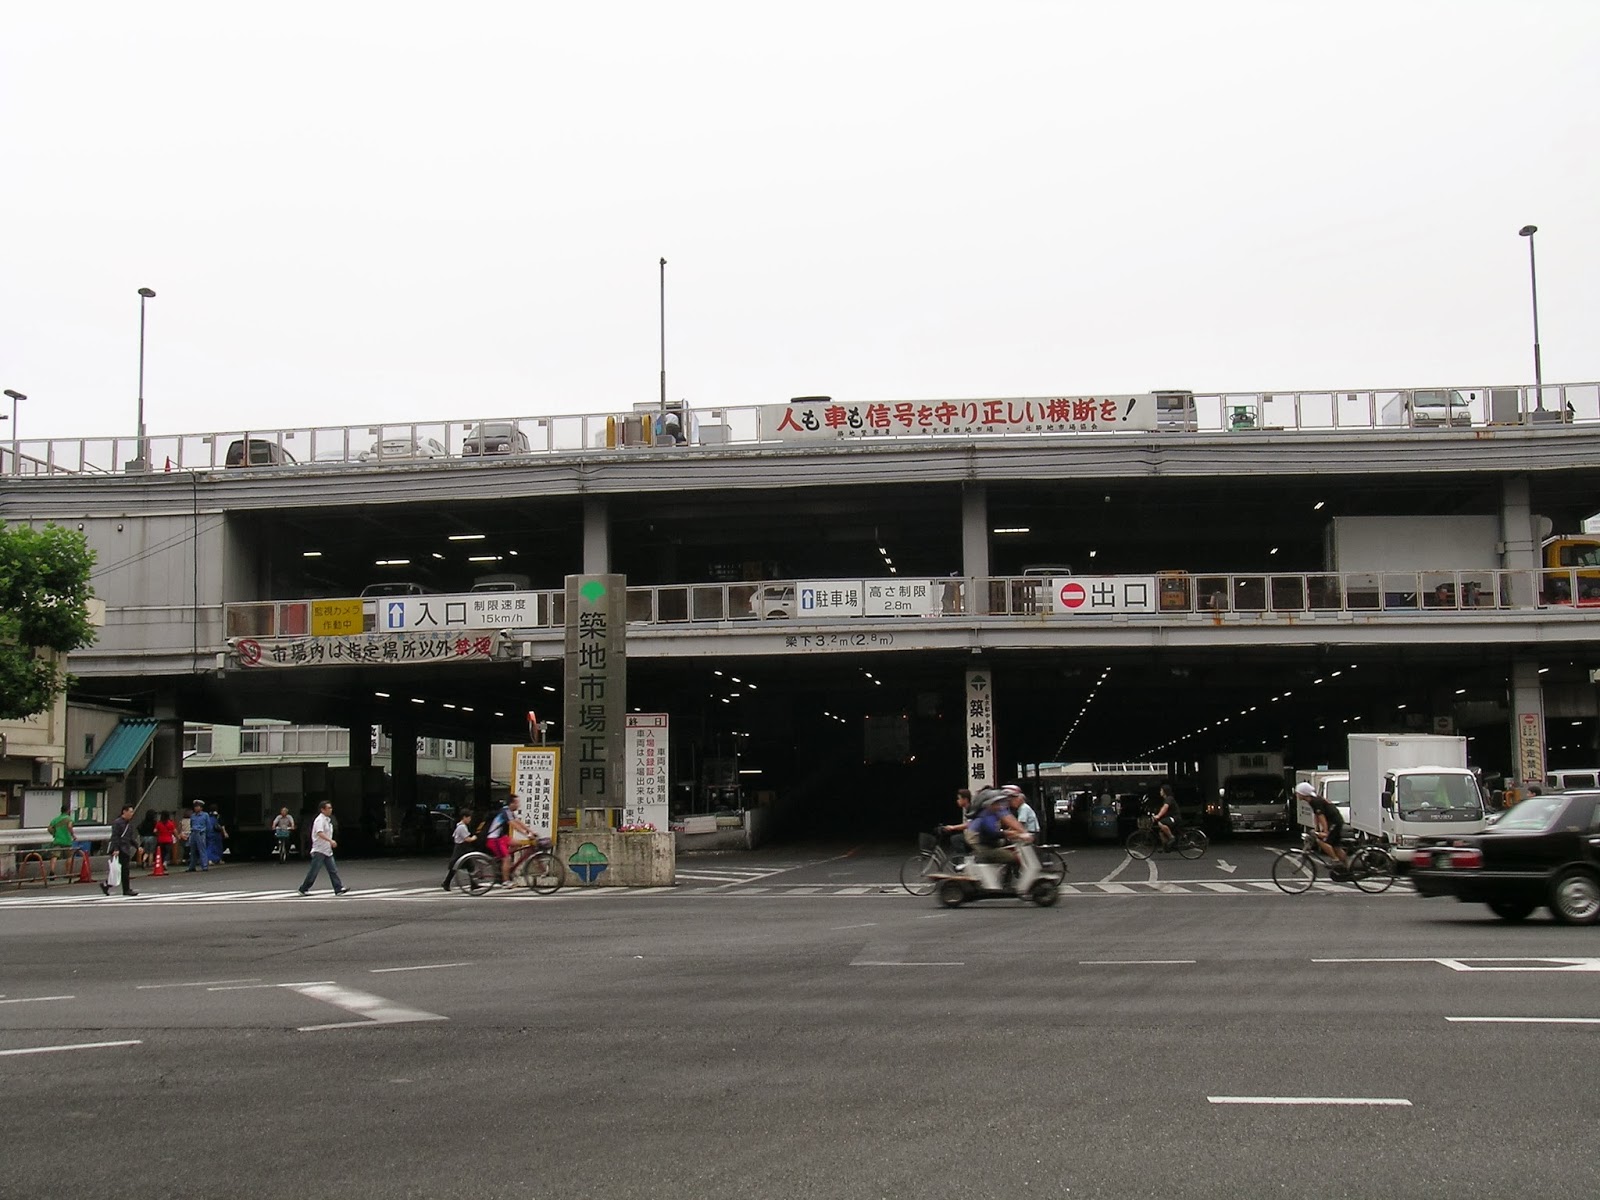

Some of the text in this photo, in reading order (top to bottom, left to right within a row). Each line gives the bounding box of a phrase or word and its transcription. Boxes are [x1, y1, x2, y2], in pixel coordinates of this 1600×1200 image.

[777, 398, 1136, 431] 人も車も信号を守り正しい横断を！
[816, 590, 858, 608] 駐車場
[869, 585, 926, 598] 高さ制限
[1091, 582, 1147, 608] 出口
[314, 605, 360, 616] 監視カメラ
[414, 602, 467, 626] 入口
[474, 599, 526, 611] 制限速度
[884, 601, 911, 610] 2.8m
[323, 620, 352, 630] 作動中
[482, 614, 523, 623] 15km/h
[579, 611, 607, 794] 築地市場正門
[629, 718, 662, 726] 終日
[970, 699, 985, 780] 築地市場
[646, 729, 655, 804] 入場登録証のない
[1526, 738, 1536, 779] 逆走禁止
[636, 729, 645, 824] 車両は入場出来ません
[656, 748, 665, 803] 車両入場規制
[541, 778, 550, 828] 車両入場規制
